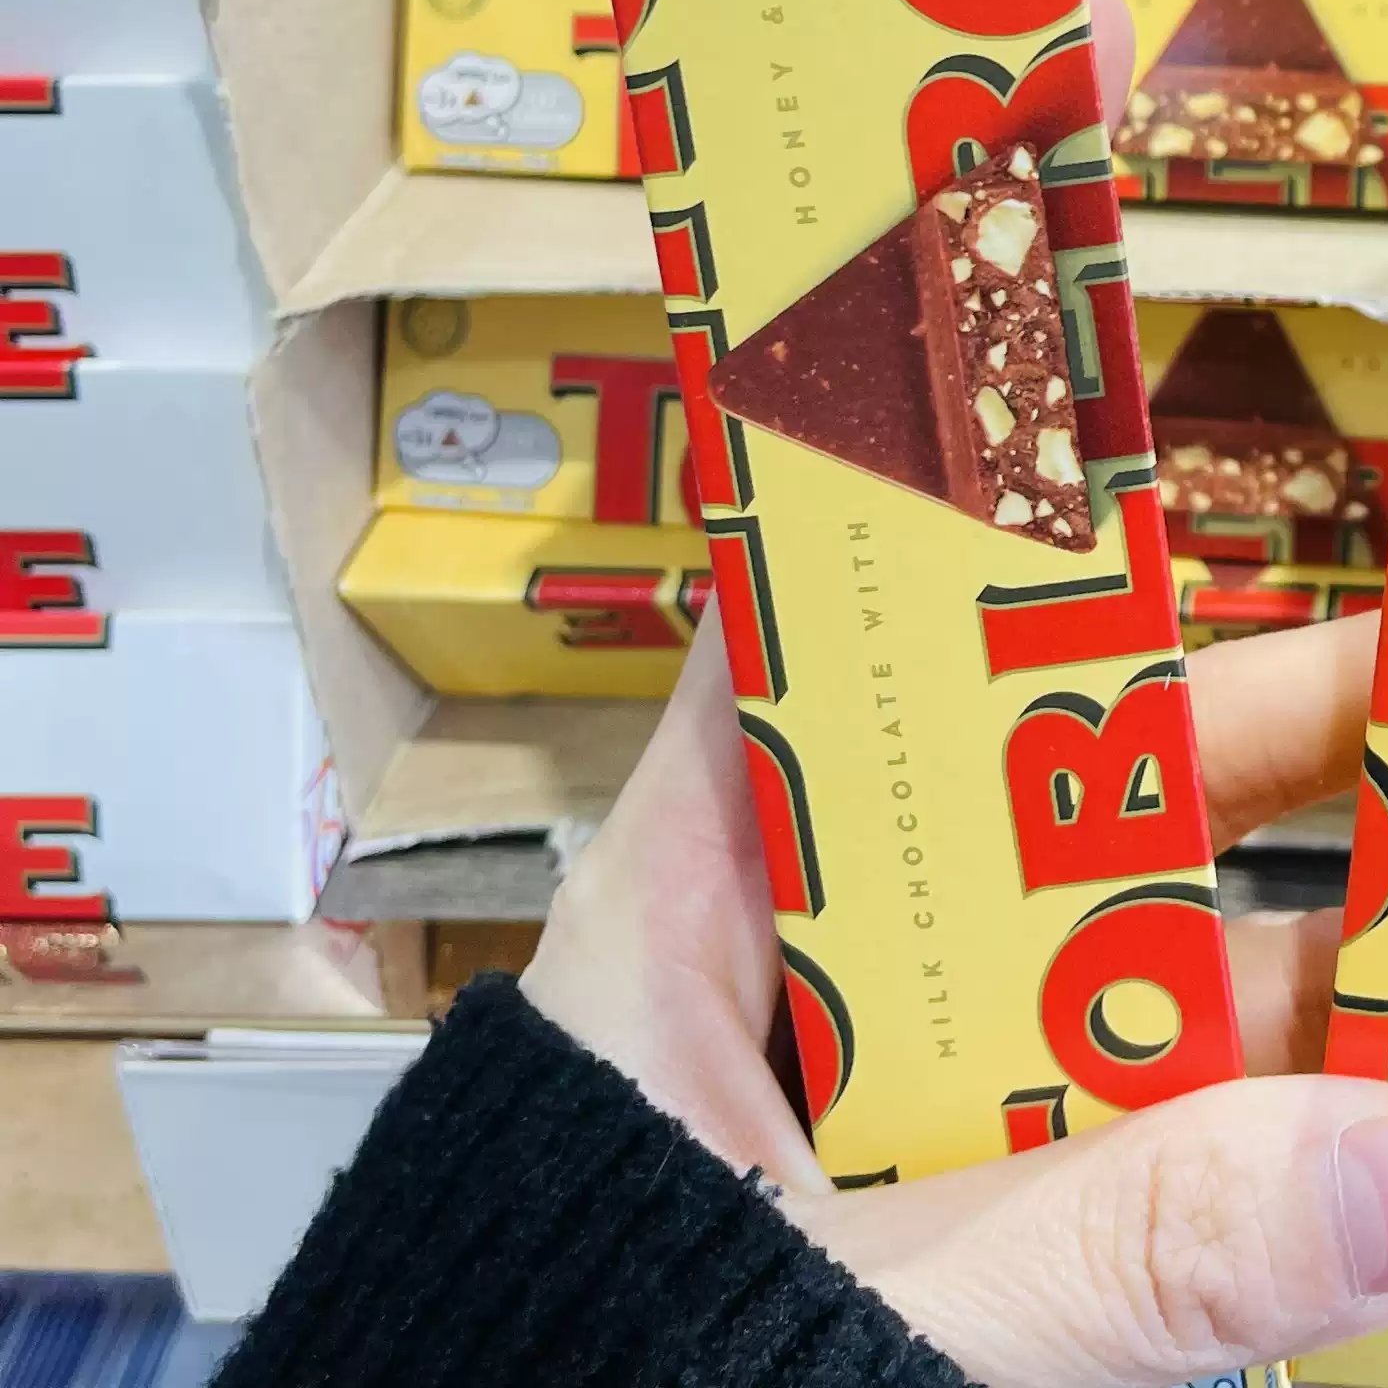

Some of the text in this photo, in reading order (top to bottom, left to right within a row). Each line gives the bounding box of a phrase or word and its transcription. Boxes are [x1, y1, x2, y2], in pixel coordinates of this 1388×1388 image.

[762, 4, 785, 25] &
[770, 61, 818, 225] HONEY
[847, 521, 884, 632] WITH
[871, 662, 935, 930] CHOCOLATE
[922, 959, 958, 1060] MILK
